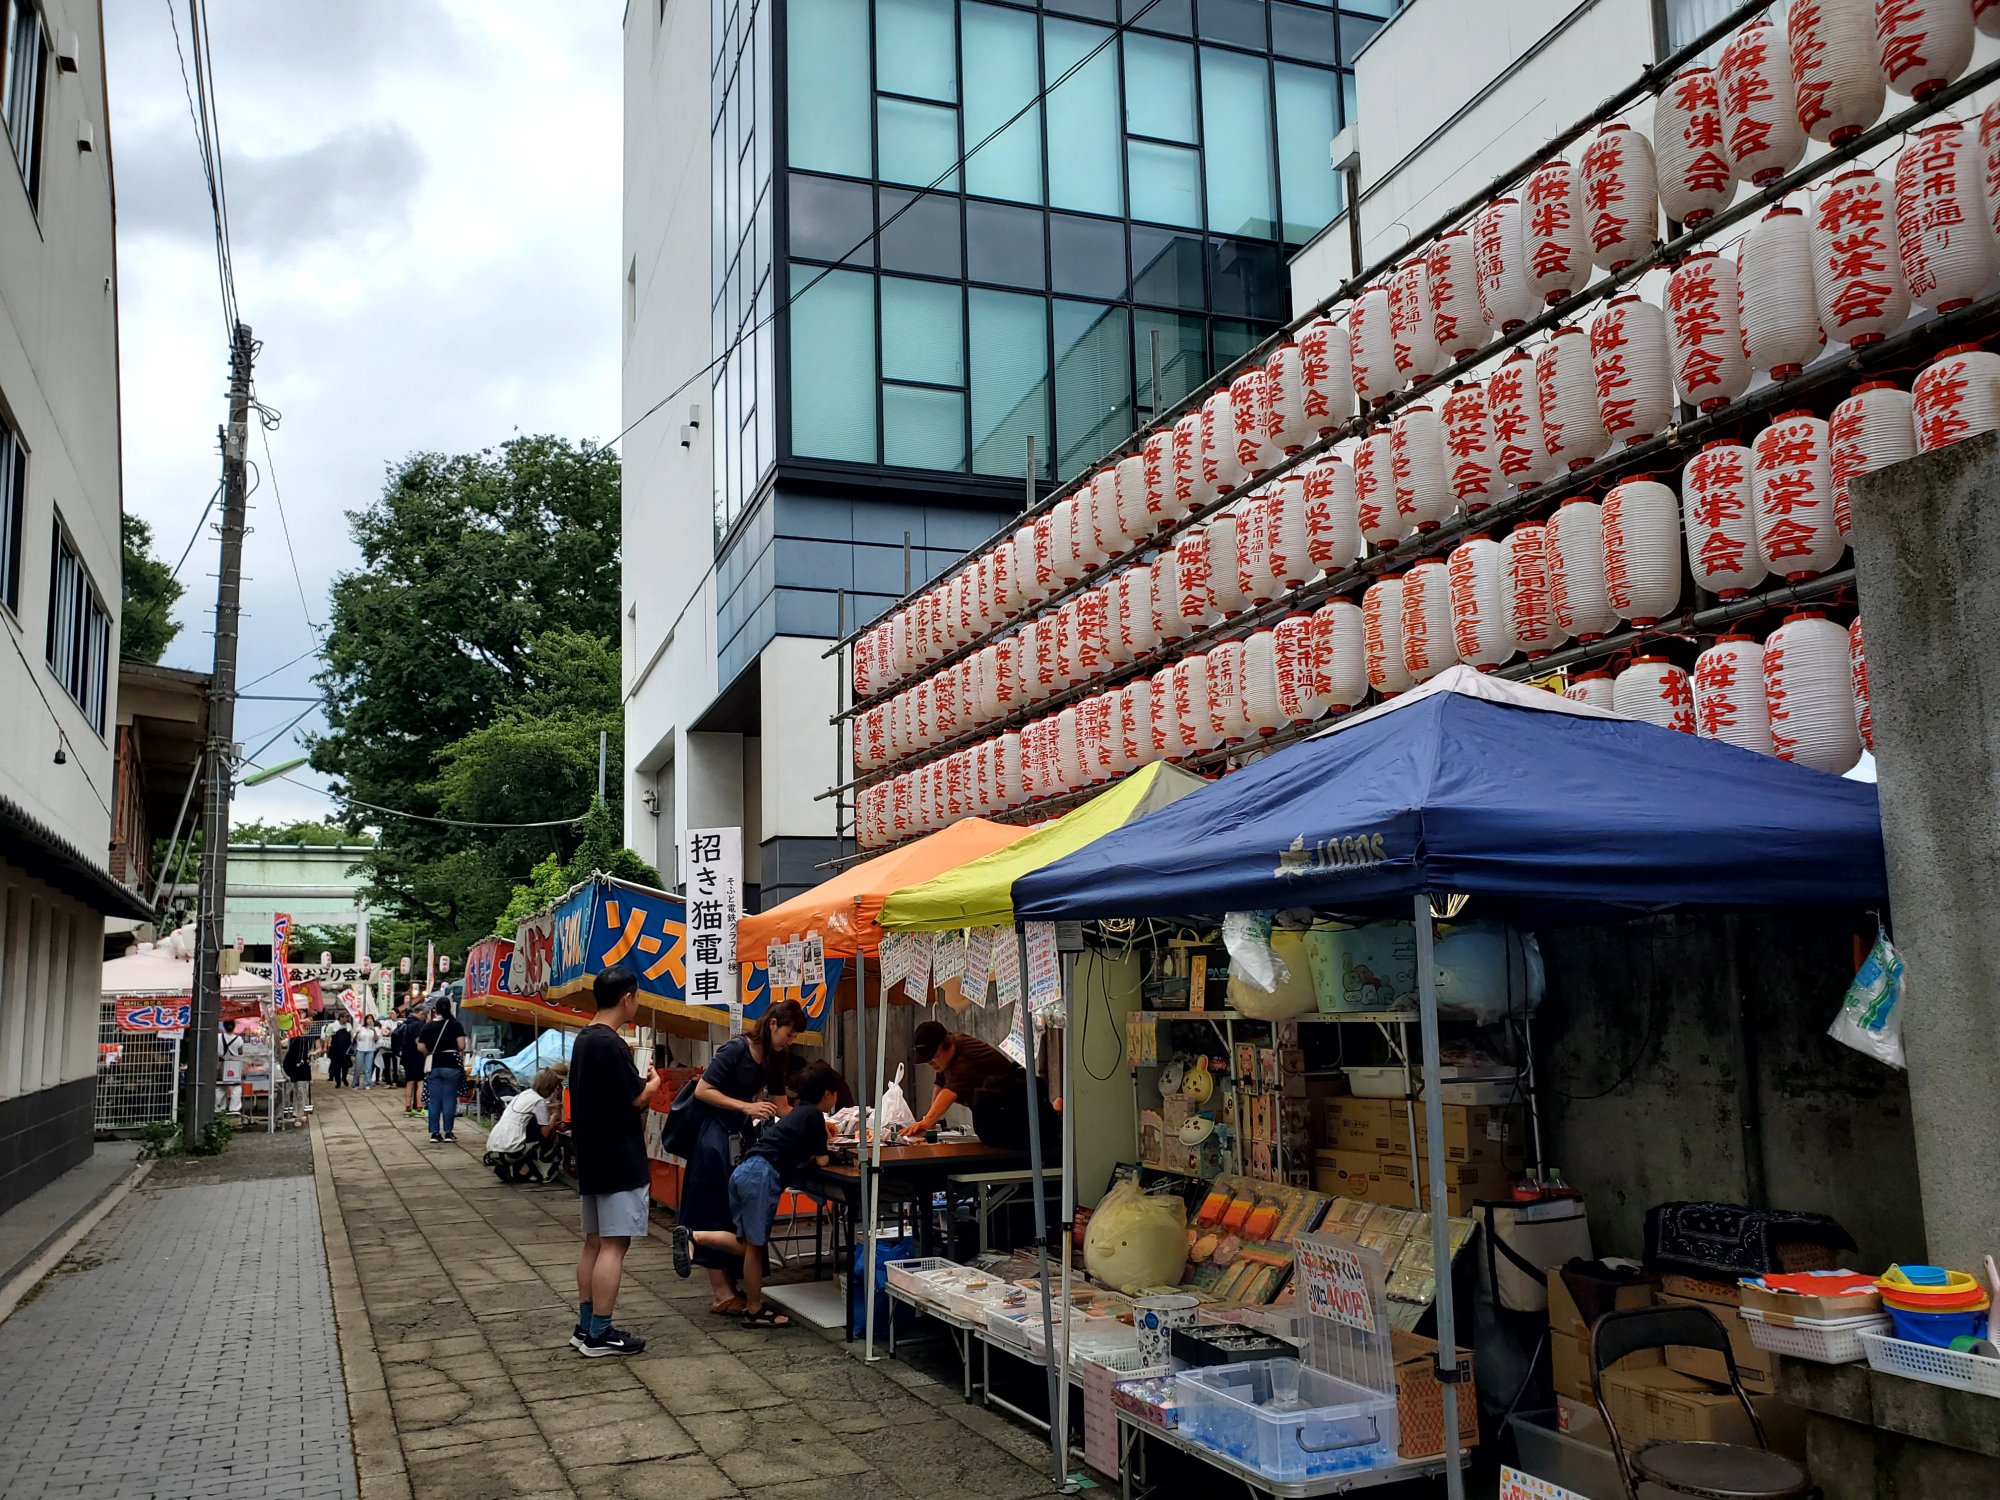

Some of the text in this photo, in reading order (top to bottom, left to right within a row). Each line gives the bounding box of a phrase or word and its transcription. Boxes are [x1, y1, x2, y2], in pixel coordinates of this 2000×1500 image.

[1719, 32, 1773, 162] 桜栄会
[1527, 170, 1571, 279] 桜栄会
[1581, 136, 1629, 253] 桜栄会
[1426, 243, 1459, 346] 桜栄会
[1818, 181, 1893, 328] 桜栄会
[1300, 331, 1330, 420] 桜栄会
[1590, 309, 1638, 435] 桜栄会
[1668, 262, 1726, 393] 桜栄会
[1231, 376, 1262, 470] 桜栄会
[1441, 392, 1492, 498] 桜栄会
[1488, 368, 1534, 477] 桜栄会
[1302, 467, 1336, 565] 桜栄会
[1690, 450, 1746, 576] 桜栄会
[1754, 423, 1819, 562] 桜栄会
[1076, 595, 1100, 668] 桜栄会
[1178, 541, 1206, 618] 桜栄会
[1449, 547, 1483, 657] 世田谷信用金庫
[691, 833, 723, 1001] 招き猫電車
[726, 877, 738, 976] そふと電鉄クラフト(株)
